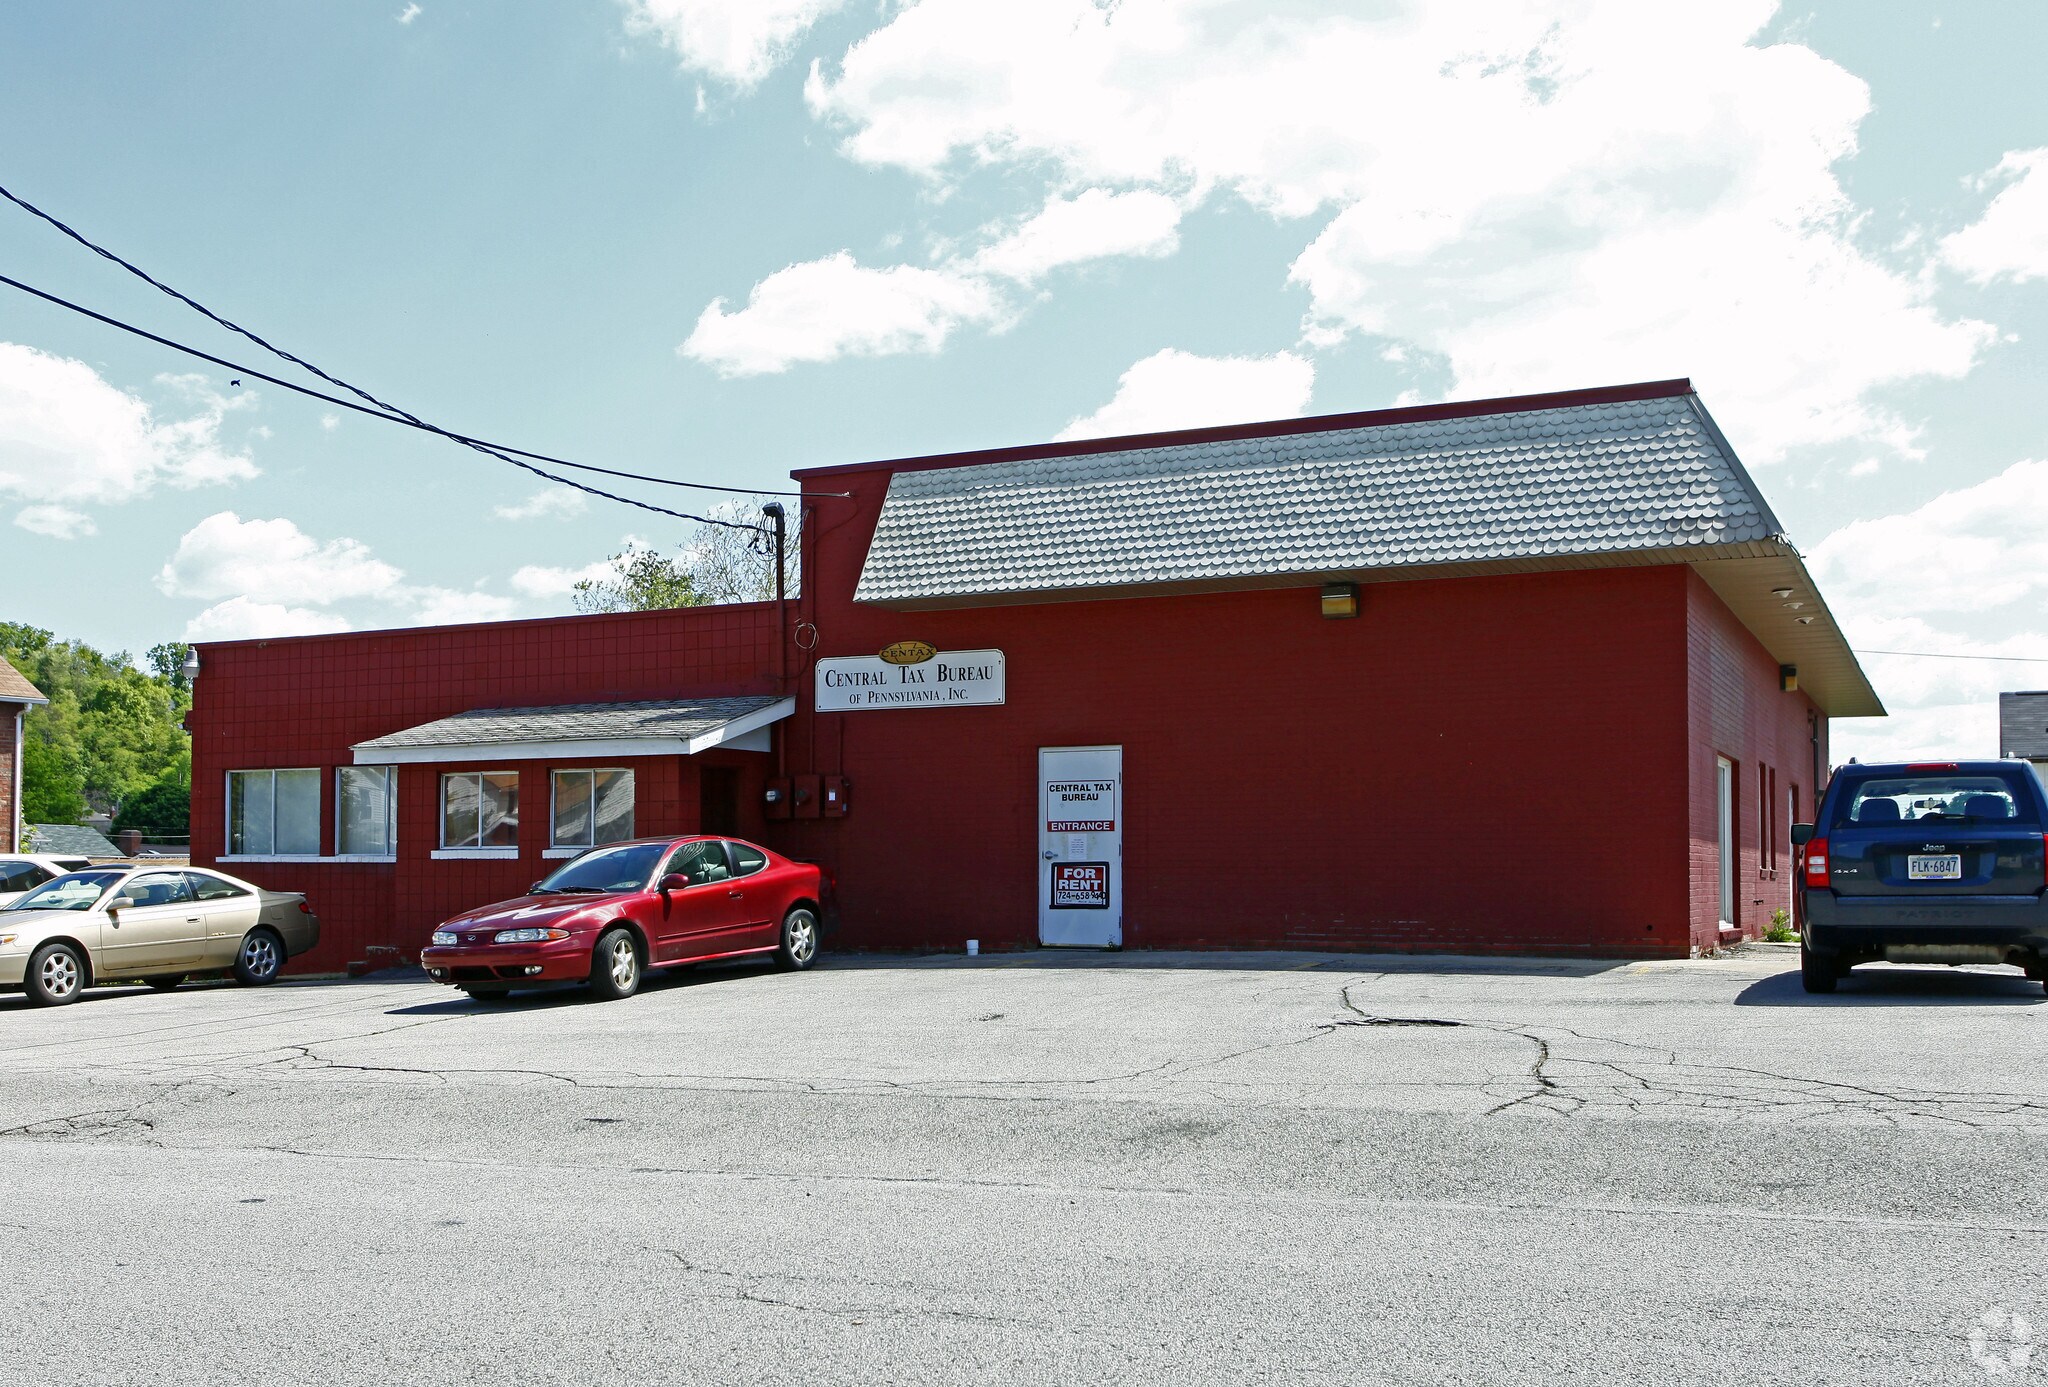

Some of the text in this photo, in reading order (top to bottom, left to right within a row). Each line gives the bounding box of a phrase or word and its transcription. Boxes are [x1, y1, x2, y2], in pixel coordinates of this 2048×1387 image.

[881, 649, 934, 658] CENTAX
[825, 663, 994, 688] CENTRAL TAX BUREAU
[849, 694, 861, 704] OF
[949, 687, 968, 700] INC.
[1049, 783, 1112, 792] CENTRAL TAX
[1062, 793, 1099, 802] BUREAU
[1051, 822, 1110, 831] ENTRANCE
[1922, 843, 1946, 852] Jeep
[1063, 868, 1096, 879] FOR
[1058, 879, 1102, 890] RENT
